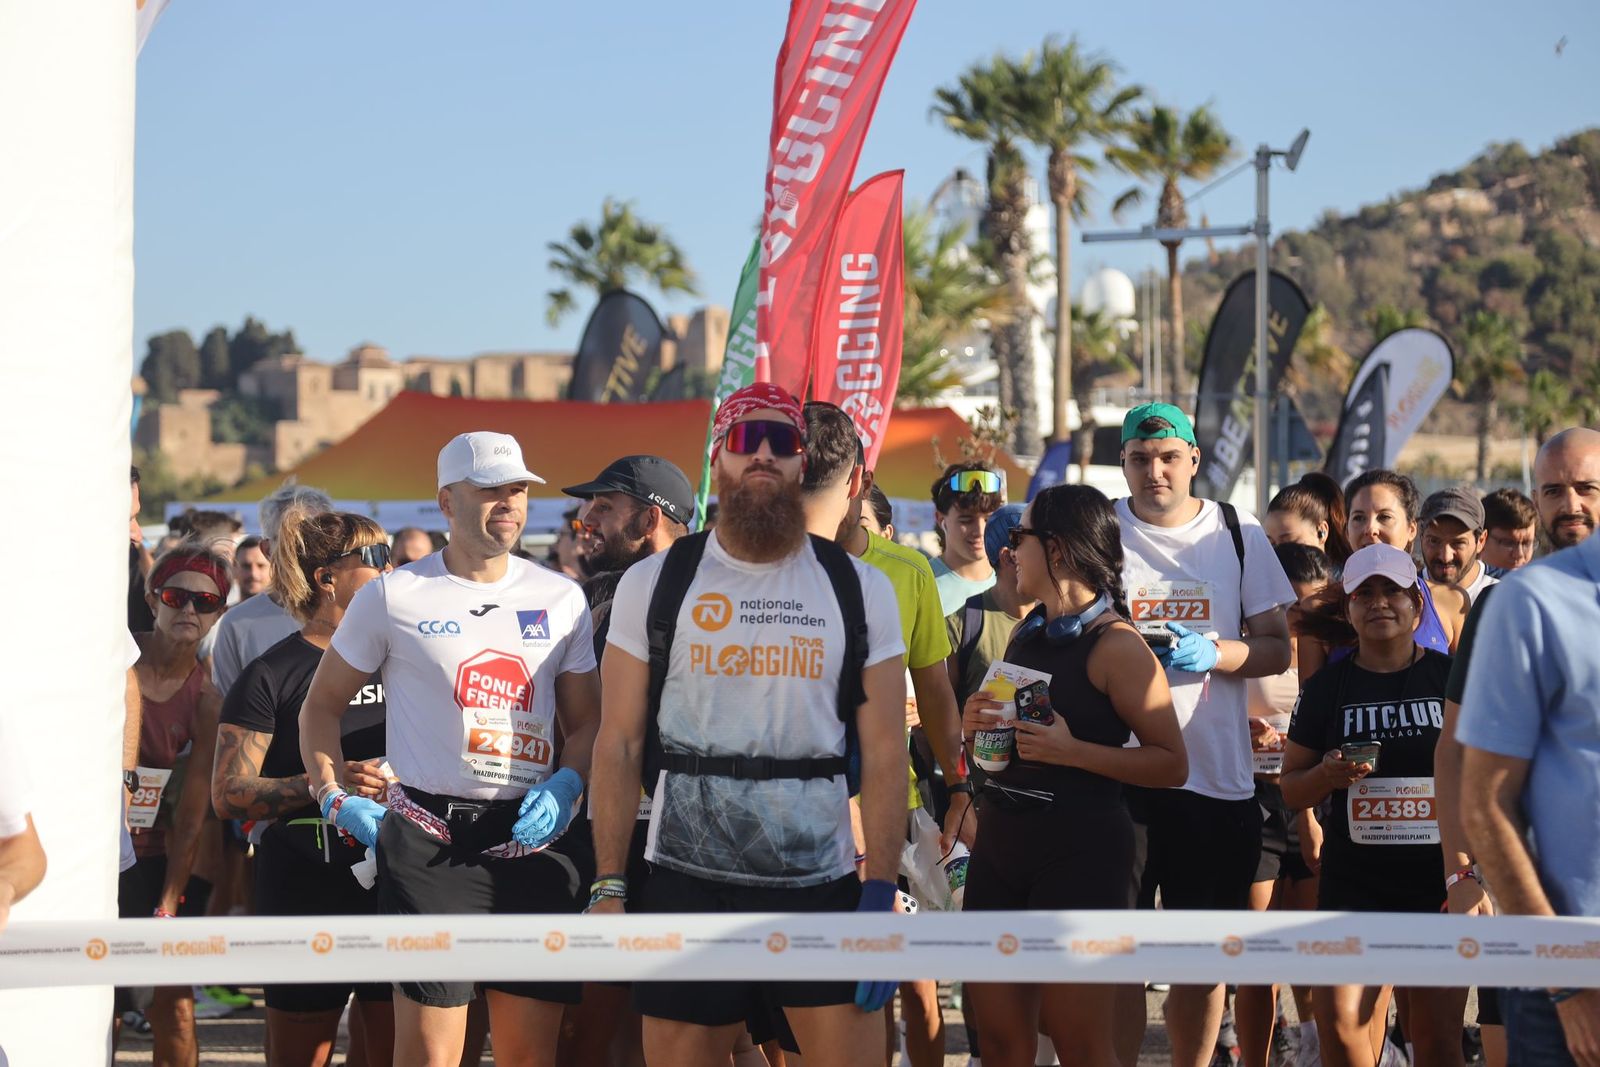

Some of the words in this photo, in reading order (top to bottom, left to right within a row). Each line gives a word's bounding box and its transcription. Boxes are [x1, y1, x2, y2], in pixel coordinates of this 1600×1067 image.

[648, 492, 676, 512] ASICS
[740, 598, 803, 611] nationale
[1138, 601, 1204, 618] 24372
[740, 612, 826, 627] nederlanden
[522, 624, 546, 637] AXA
[790, 635, 824, 648] TOUR
[690, 643, 825, 680] PLOGGING
[468, 670, 526, 700] PONLE
[1343, 701, 1444, 738] FITCLUB
[1371, 729, 1422, 739] MALAGA
[476, 732, 546, 760] 24941
[1357, 799, 1431, 819] 24389
